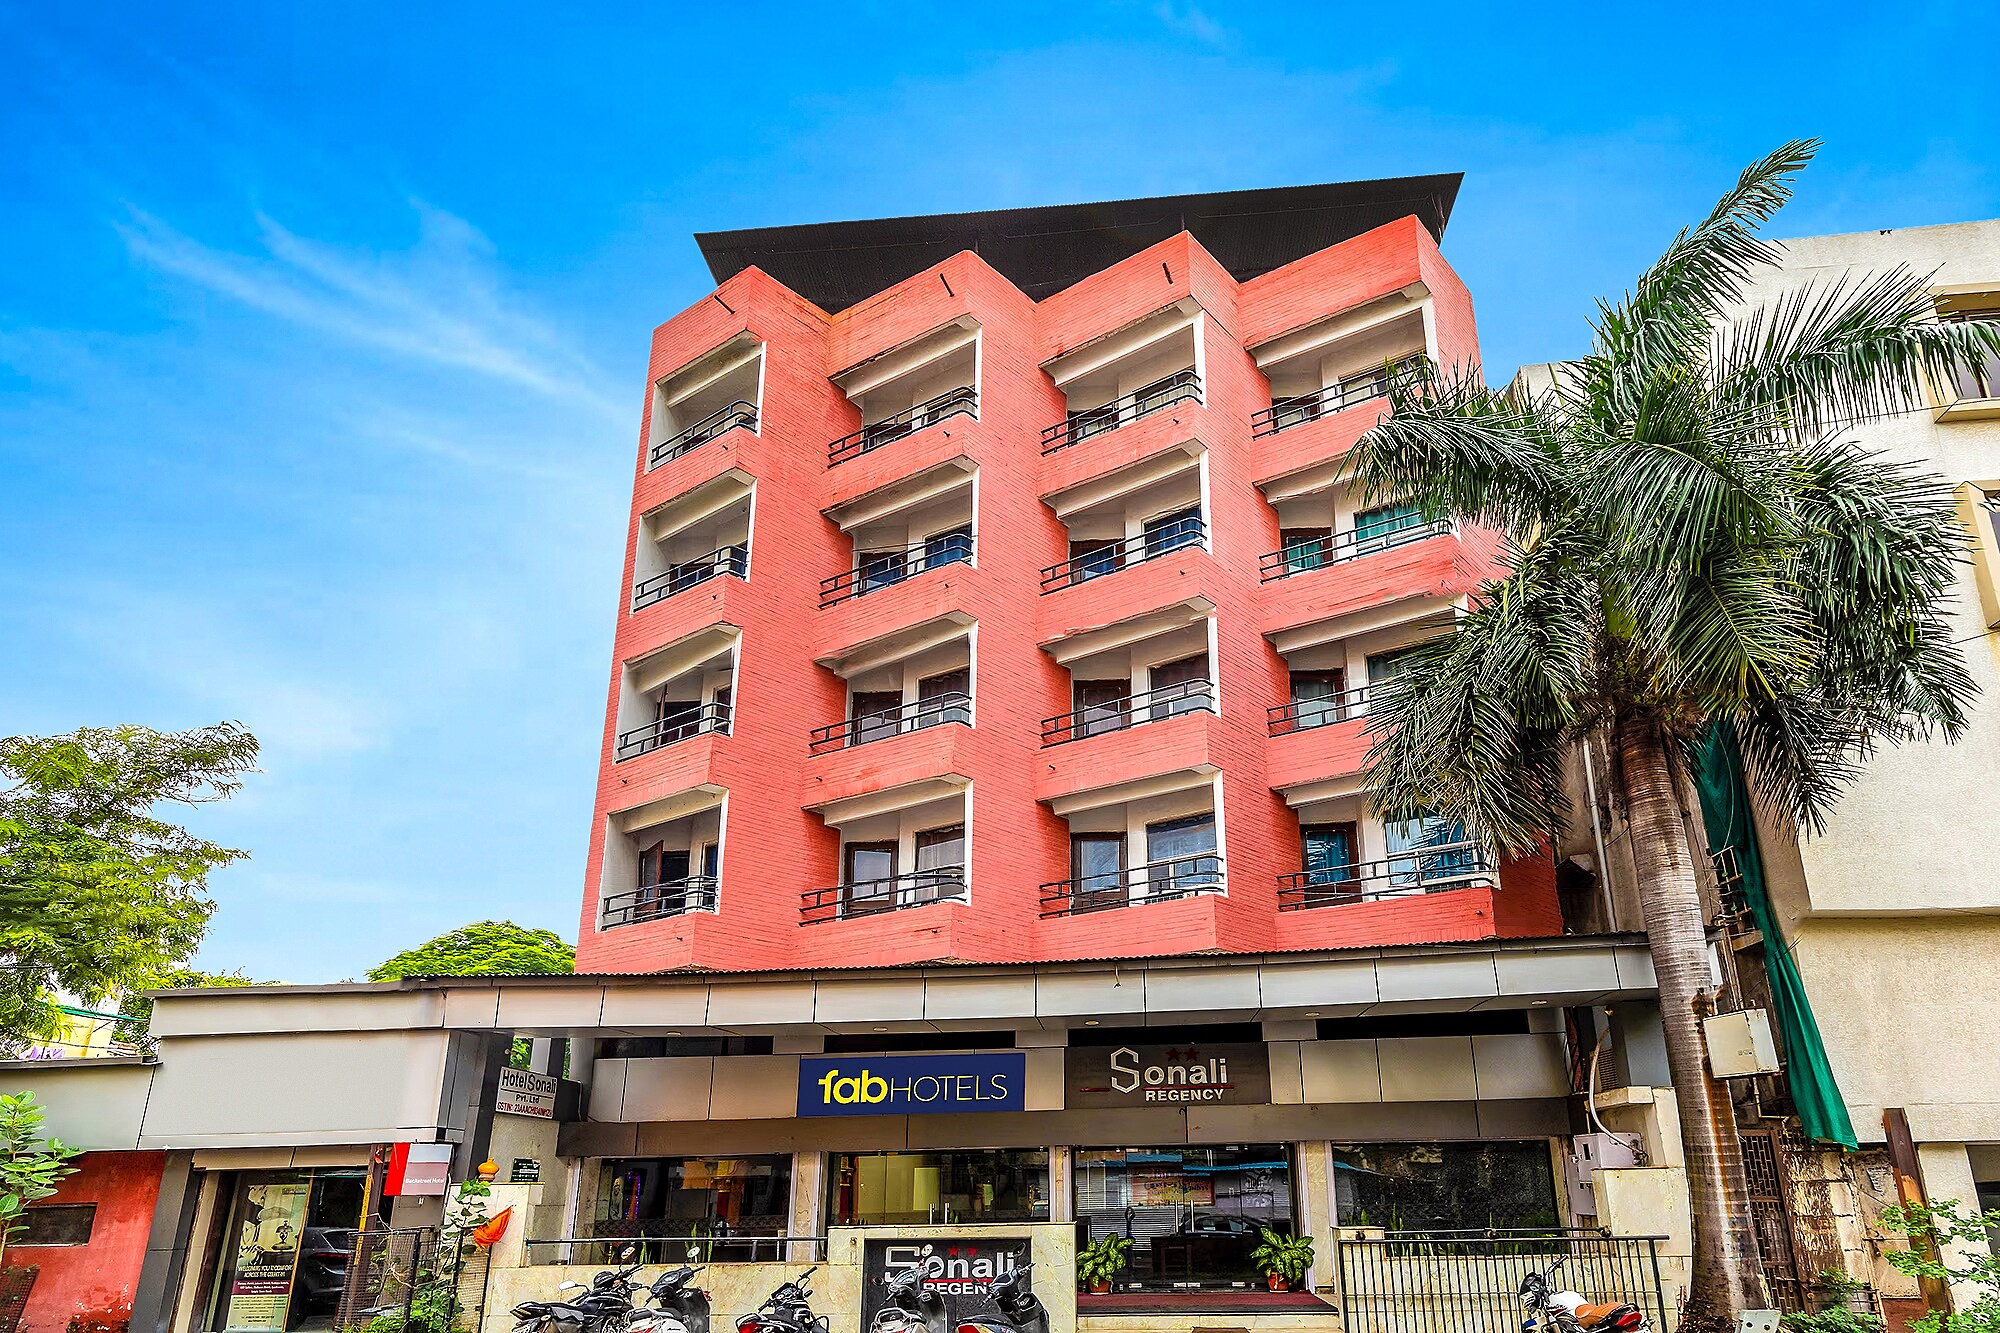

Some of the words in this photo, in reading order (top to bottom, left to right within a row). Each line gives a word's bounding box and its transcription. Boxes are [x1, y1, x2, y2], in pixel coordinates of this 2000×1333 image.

[502, 1069, 527, 1089] Hotel
[527, 1073, 557, 1094] Sonali
[1110, 1046, 1228, 1094] Sonali
[1145, 1089, 1224, 1101] REGENCY
[885, 1246, 1015, 1283] Sonali
[923, 1282, 988, 1295] REGEN
